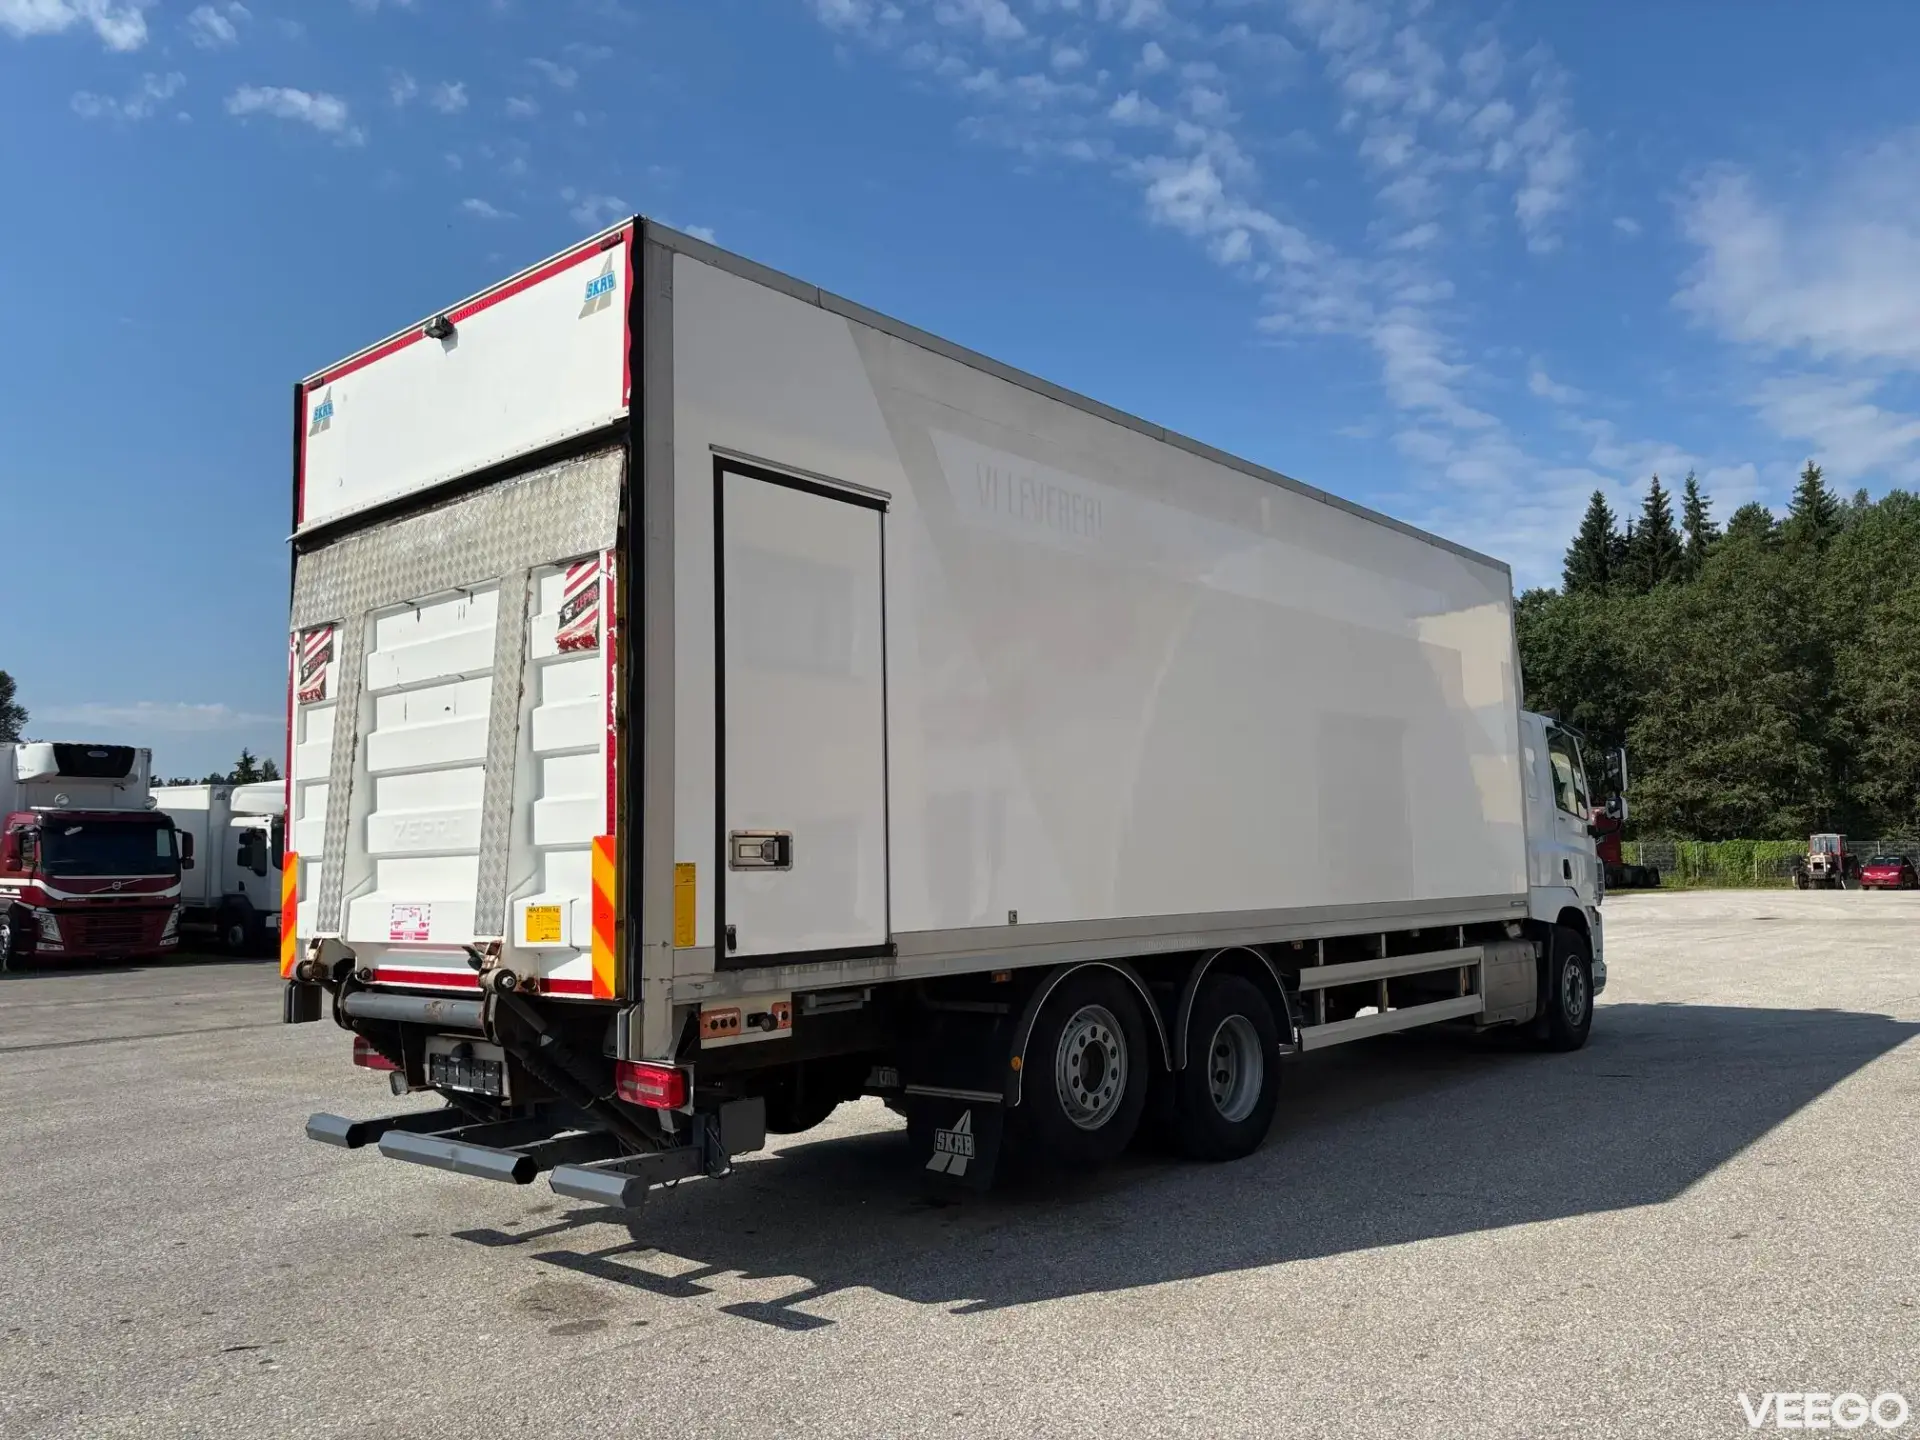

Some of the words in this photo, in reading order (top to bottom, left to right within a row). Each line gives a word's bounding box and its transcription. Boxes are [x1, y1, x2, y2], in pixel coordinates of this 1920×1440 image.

[585, 272, 615, 299] SKAB
[313, 402, 333, 421] SKAB
[976, 462, 998, 514] VI
[936, 1131, 973, 1157] SKAB
